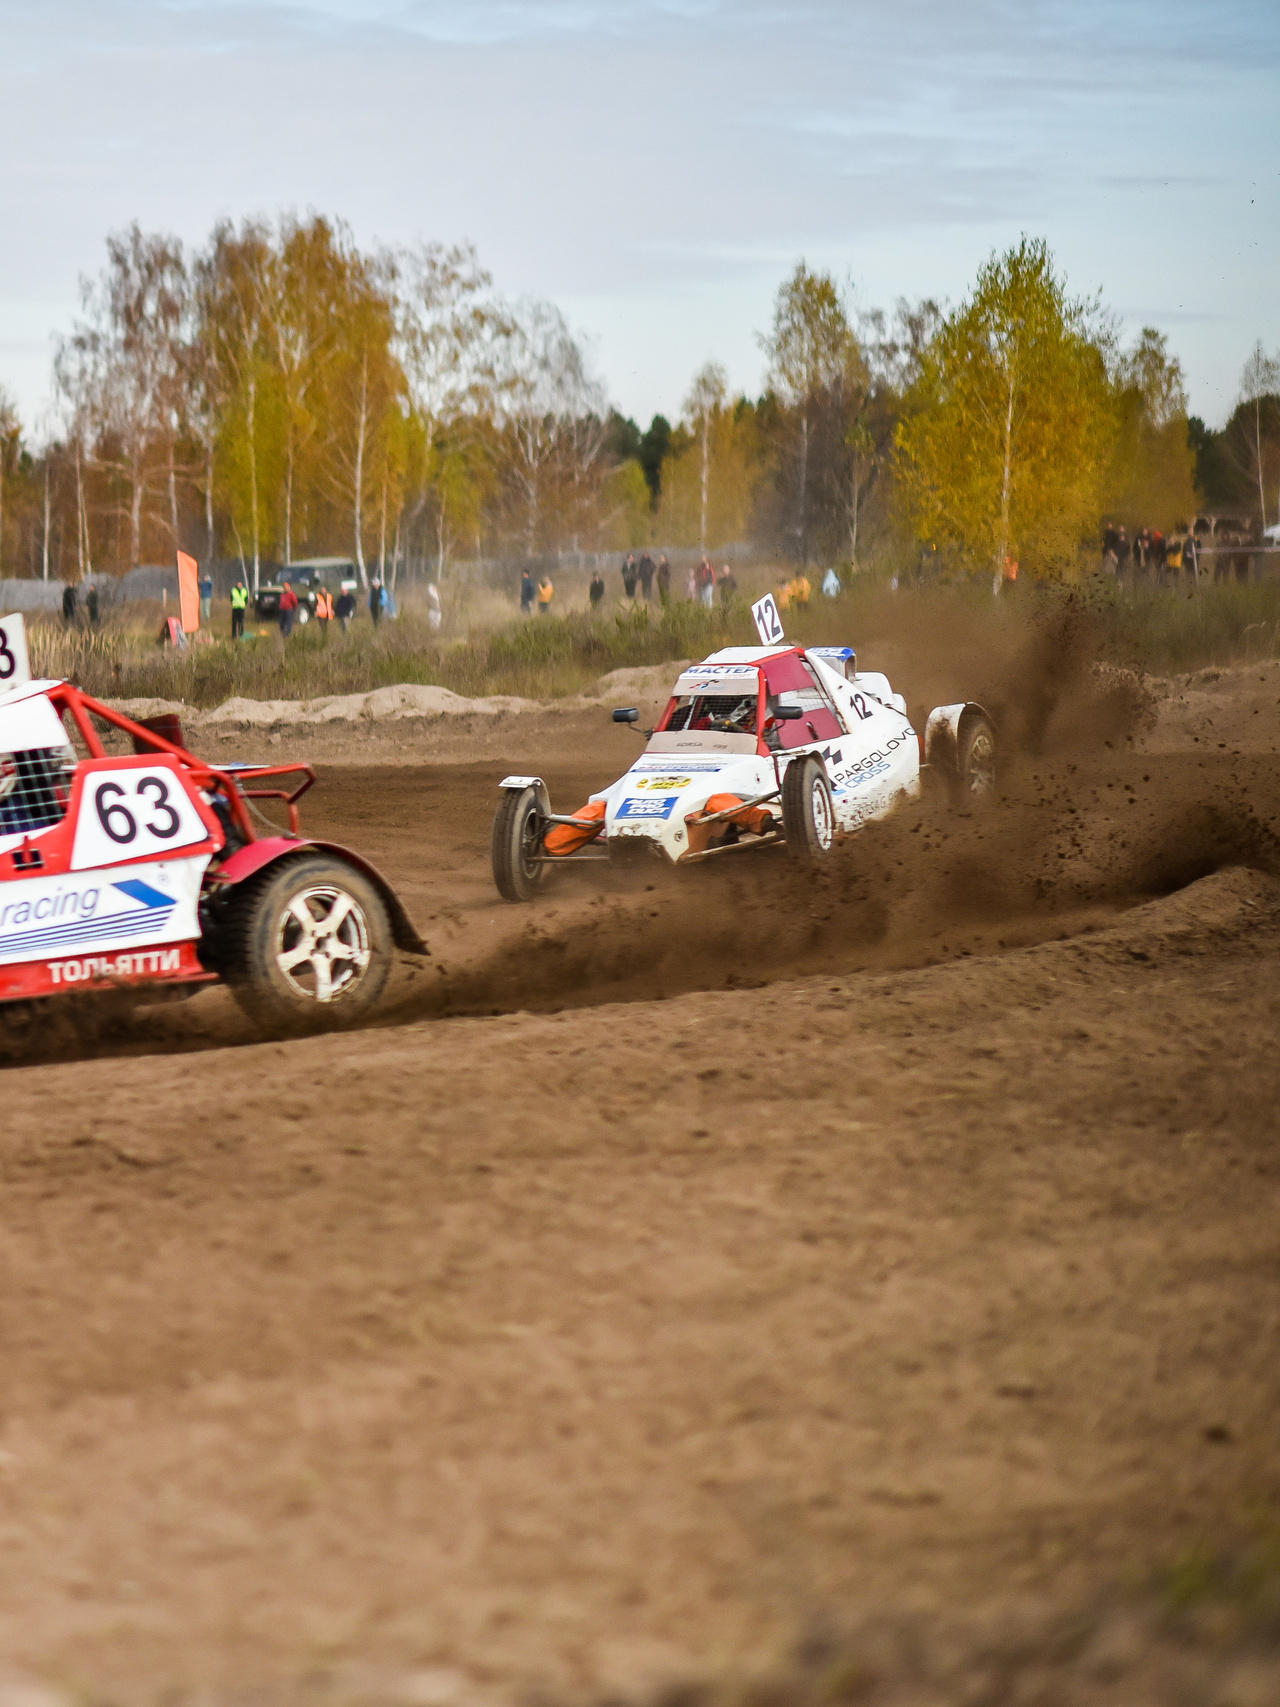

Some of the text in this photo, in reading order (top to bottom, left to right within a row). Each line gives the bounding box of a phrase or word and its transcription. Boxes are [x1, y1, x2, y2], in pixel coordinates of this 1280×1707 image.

[757, 599, 781, 642] 12
[849, 693, 874, 721] 12
[844, 760, 892, 789] CROSS
[95, 776, 181, 845] 63
[0, 886, 102, 926] racing
[47, 948, 182, 984] ТОЛЬЯТТИ
